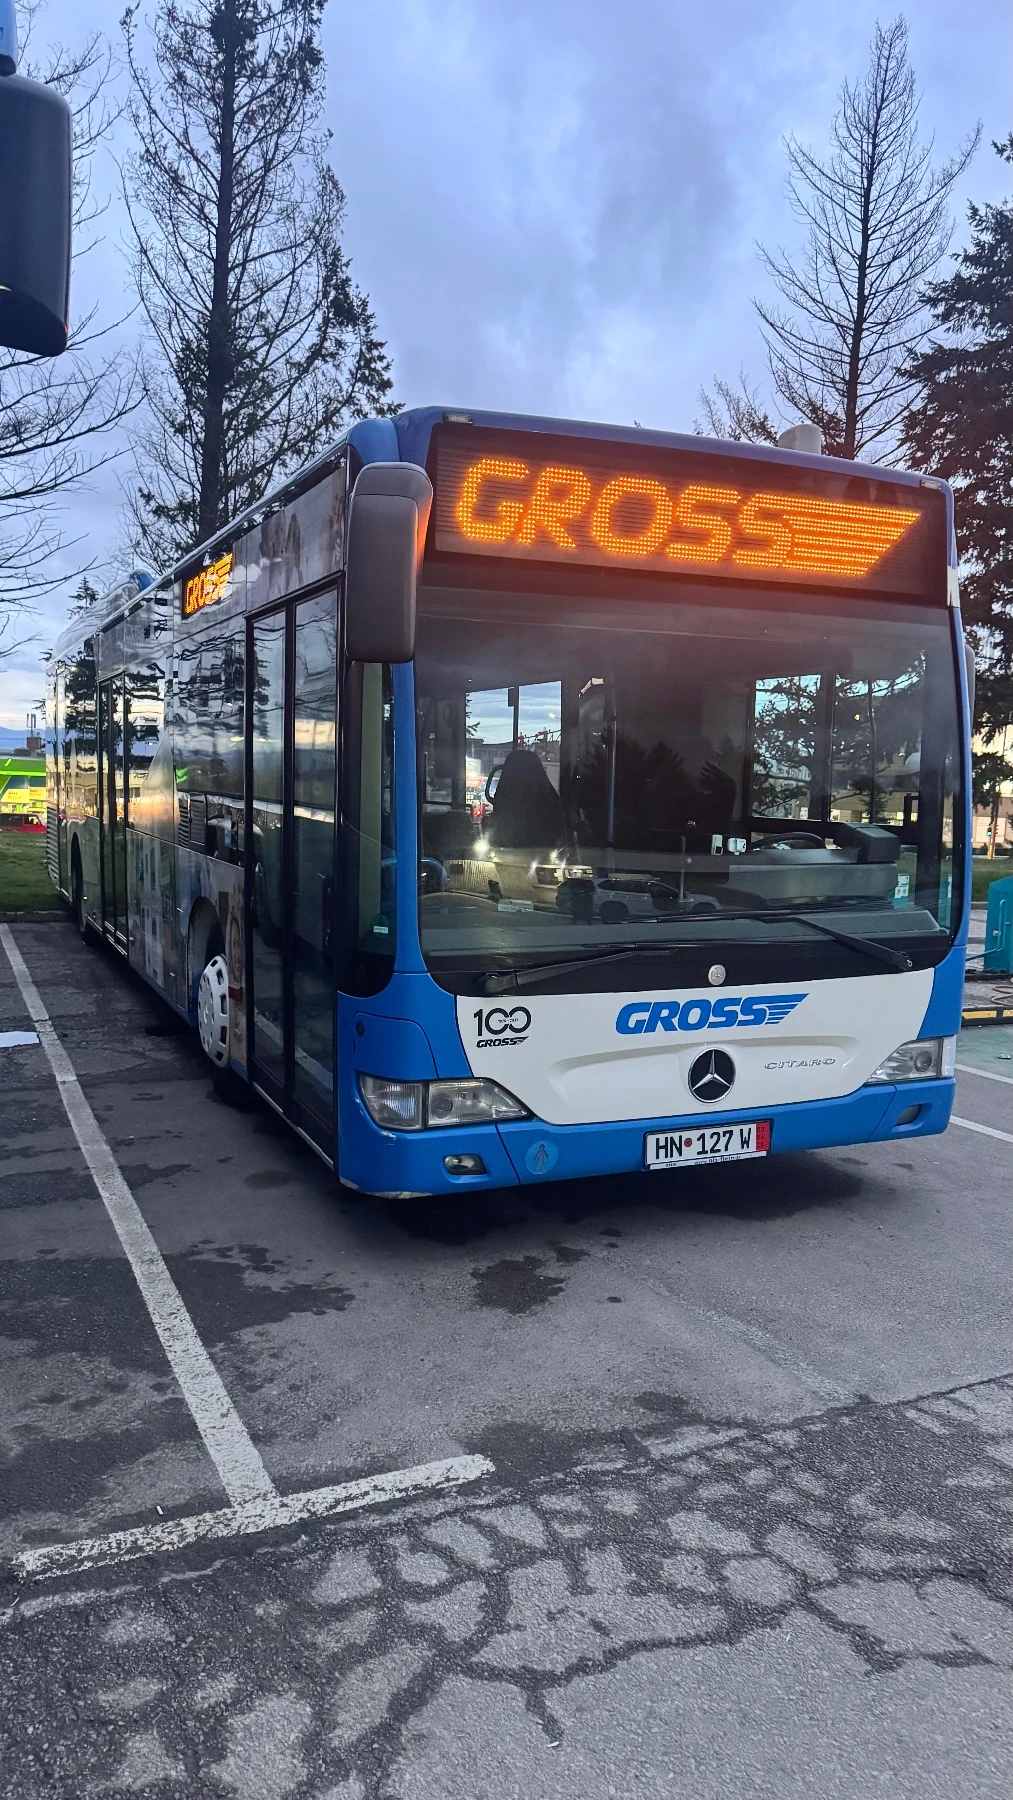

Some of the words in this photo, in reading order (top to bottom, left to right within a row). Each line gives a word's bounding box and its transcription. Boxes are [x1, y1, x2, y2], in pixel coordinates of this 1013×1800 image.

[456, 457, 922, 576] GROSS
[473, 1006, 532, 1037] 100
[615, 992, 810, 1035] GROSS
[476, 1036, 530, 1048] GROSS
[764, 1058, 837, 1070] CITARO
[655, 1135, 683, 1160] HN
[696, 1129, 734, 1156] 127
[739, 1127, 752, 1150] W
